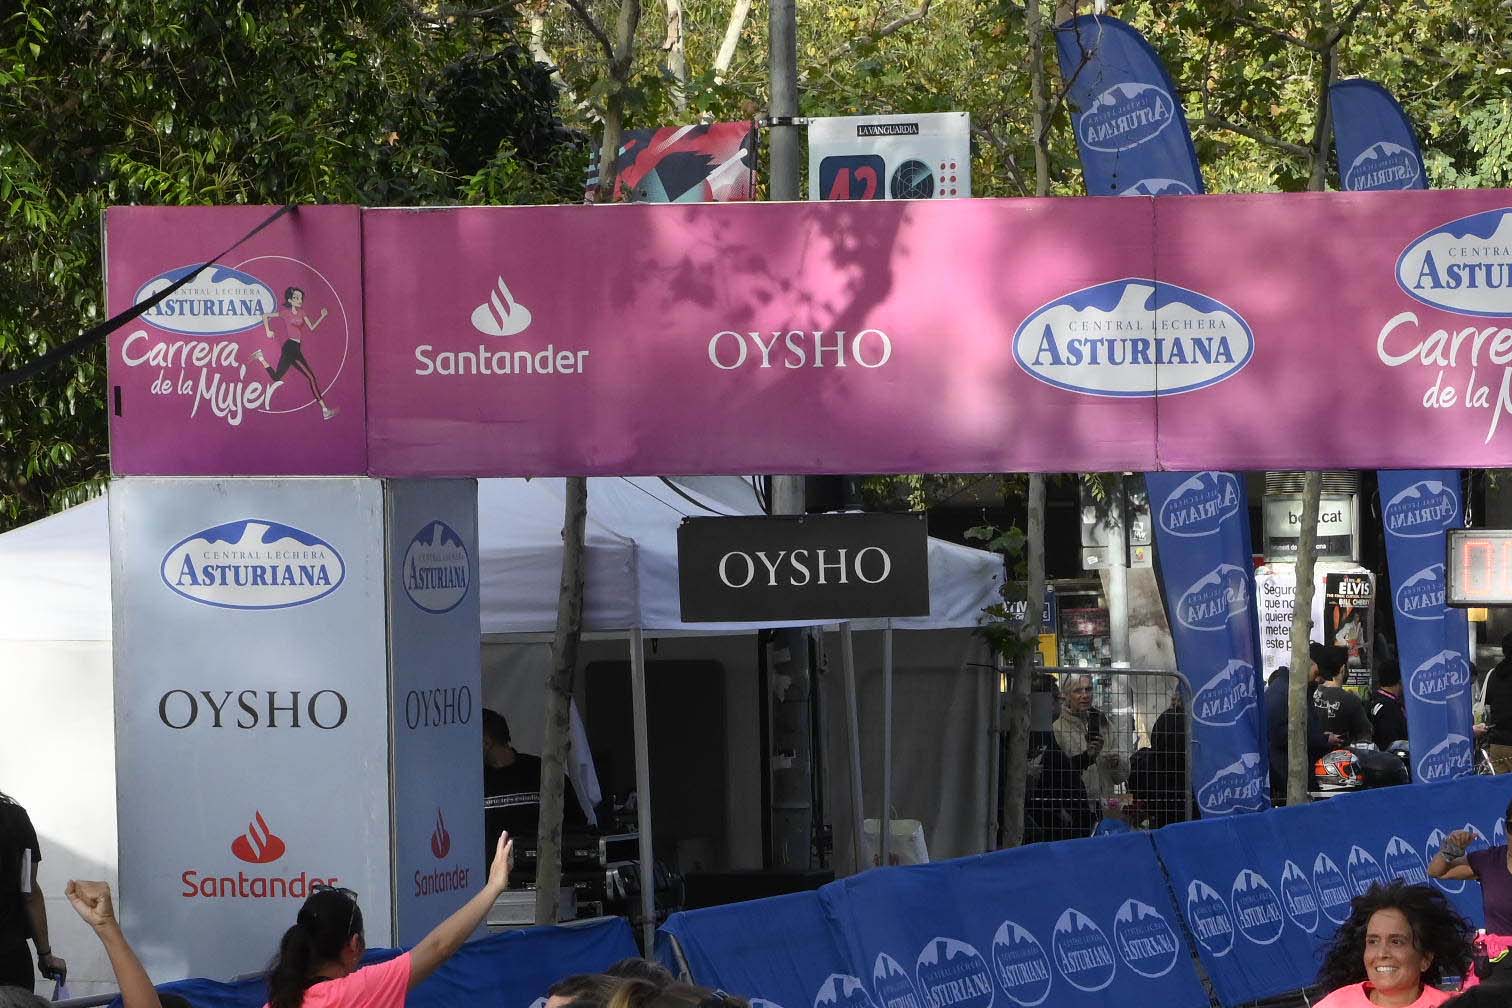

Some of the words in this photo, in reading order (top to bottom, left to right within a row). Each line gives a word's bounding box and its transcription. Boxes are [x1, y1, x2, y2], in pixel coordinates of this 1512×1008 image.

[171, 288, 210, 296] ENTRAL
[215, 288, 261, 296] LECHERA
[1068, 319, 1144, 332] CENTRAL
[1151, 318, 1228, 331] LECHERA
[121, 329, 241, 368] Carrera
[415, 343, 590, 376] Santander
[708, 328, 892, 370] OYSHO
[1032, 323, 1236, 367] ASTURIANA
[150, 369, 173, 395] de
[177, 369, 194, 395] la
[190, 364, 285, 427] Mujer
[1422, 369, 1458, 409] de
[1465, 367, 1490, 409] la
[175, 553, 332, 587] ASTURIANA
[203, 551, 260, 561] CENTRAL
[266, 550, 326, 561] LECHERA
[408, 554, 466, 591] ASTURIANA
[718, 546, 892, 588] OYSHO
[1264, 599, 1280, 610] que
[1338, 581, 1370, 595] ELVIS
[1265, 637, 1284, 649] este
[158, 689, 348, 730] OYSHO
[405, 684, 472, 730] OYSHO
[413, 866, 470, 897] Santander
